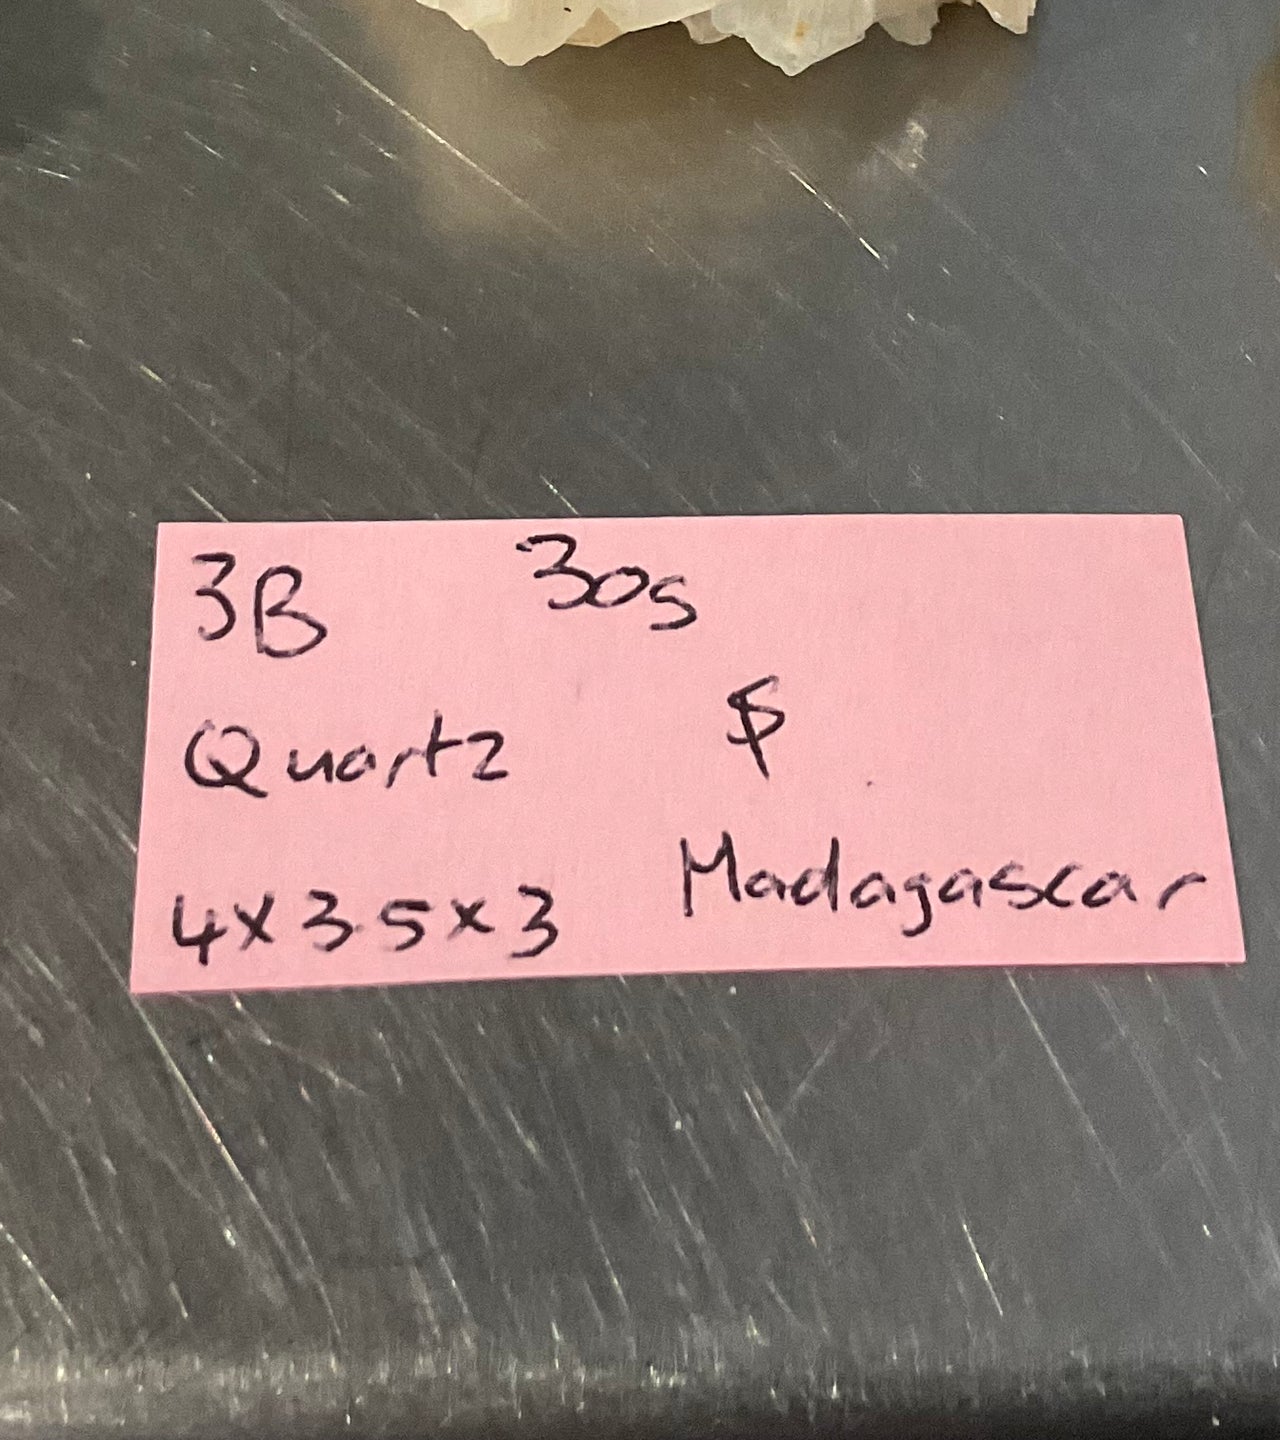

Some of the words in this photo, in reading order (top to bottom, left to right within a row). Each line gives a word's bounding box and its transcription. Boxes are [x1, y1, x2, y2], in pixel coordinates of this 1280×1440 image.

[193, 552, 330, 660] 3B
[182, 708, 511, 800] Quartz
[724, 673, 787, 780] $
[678, 829, 1209, 939] Madagascar
